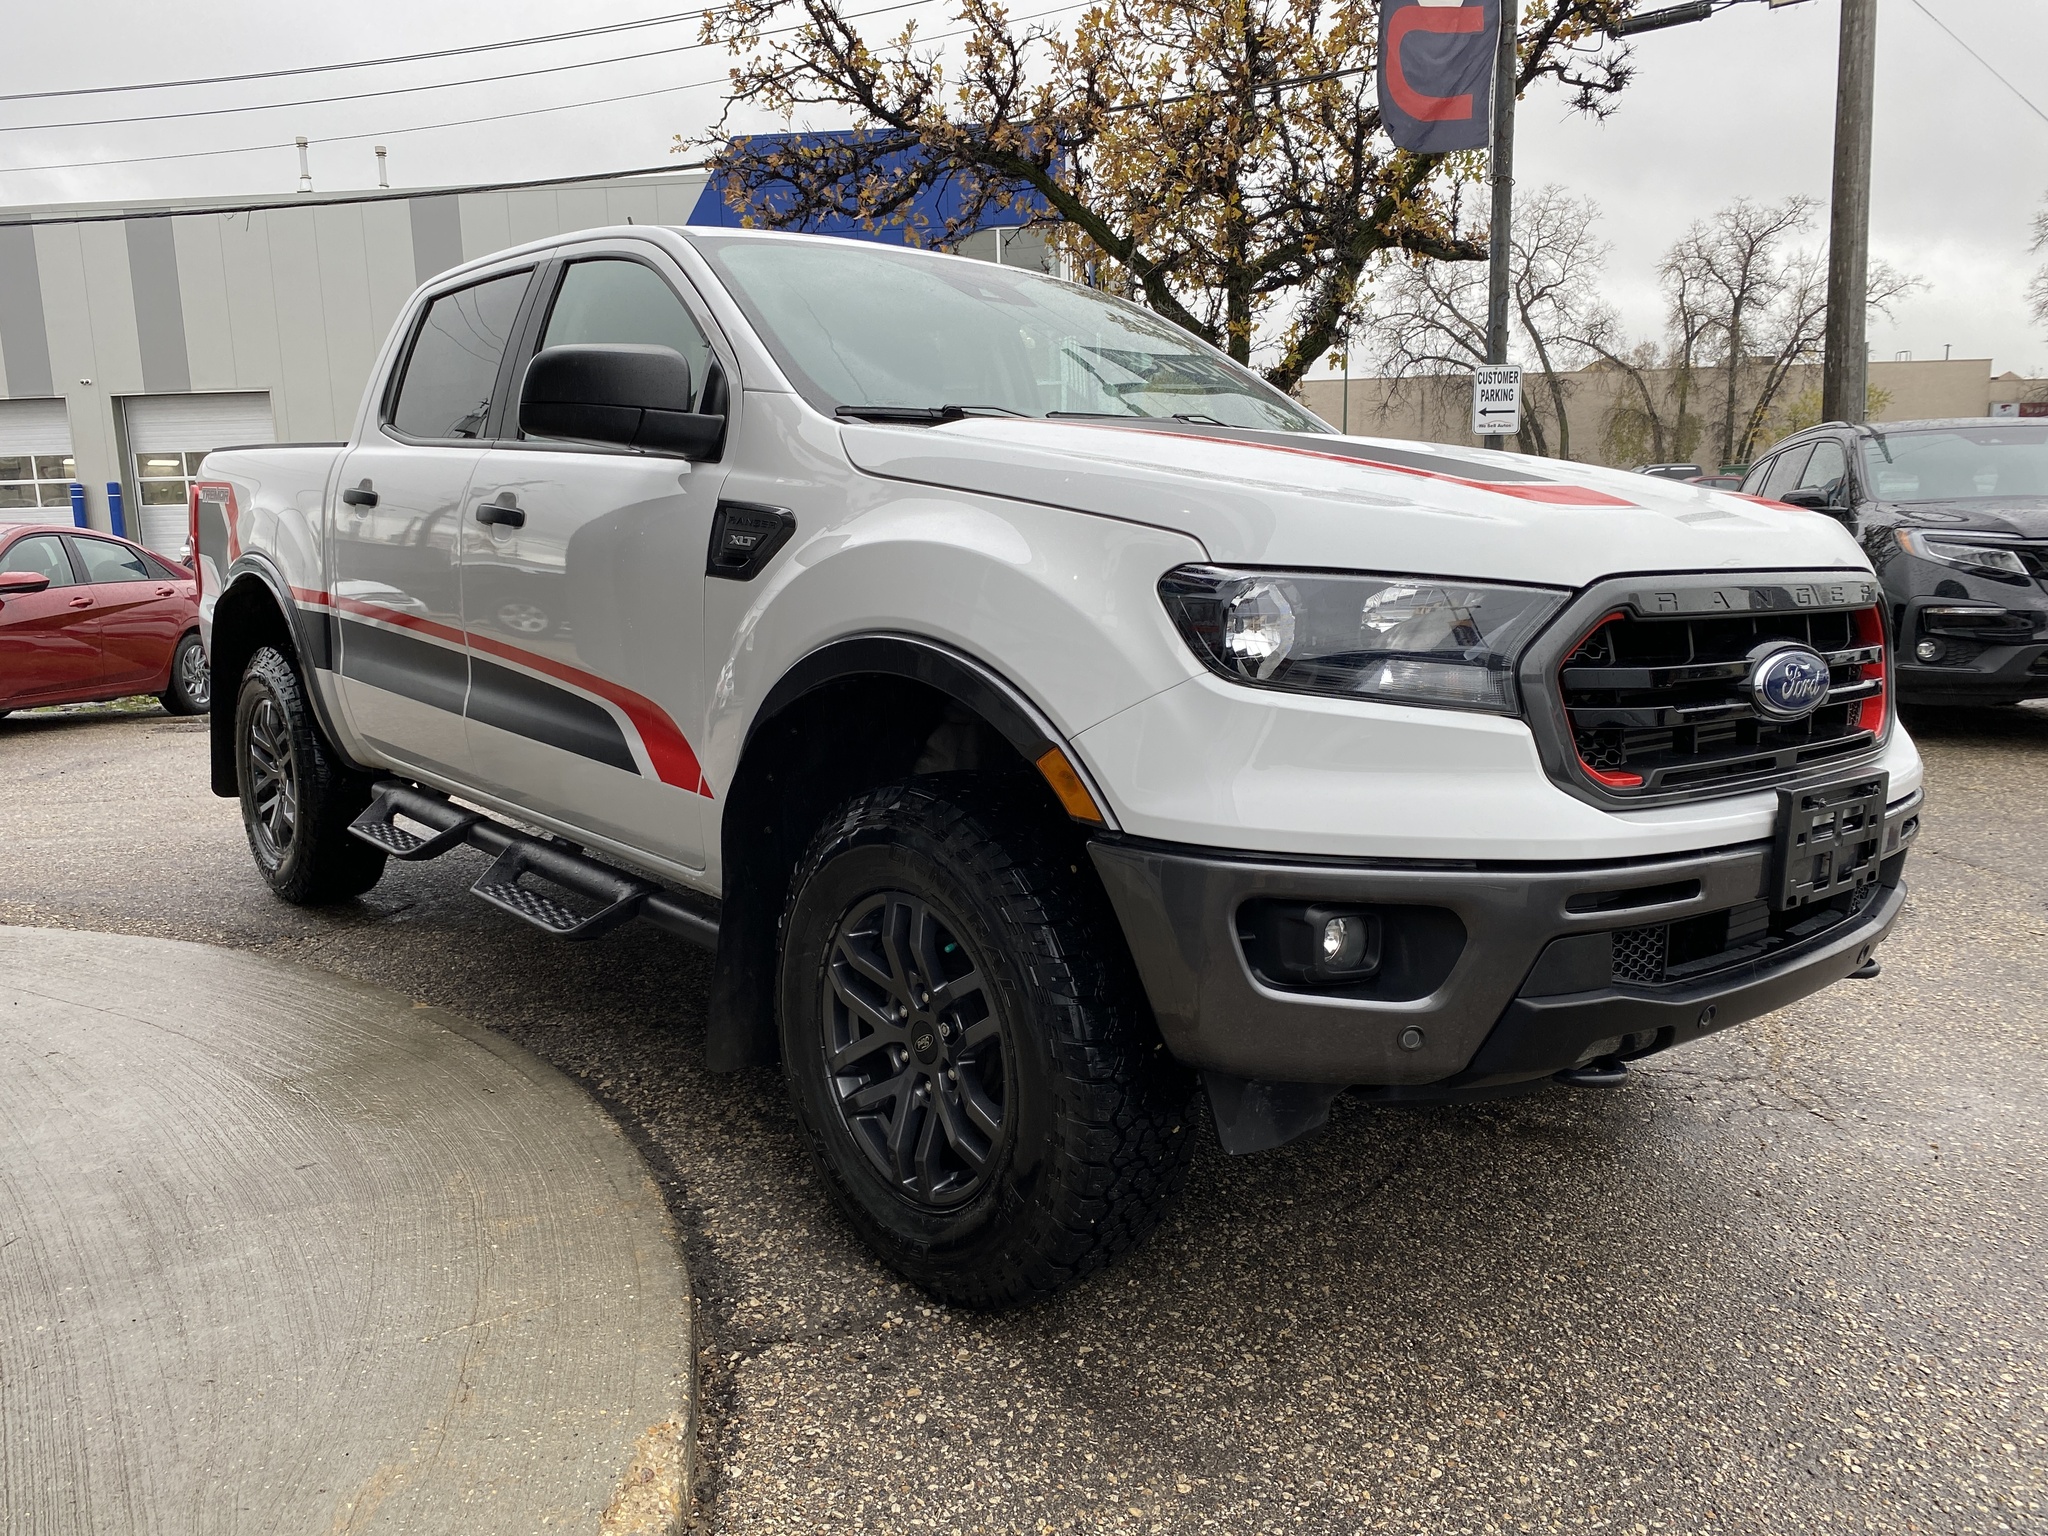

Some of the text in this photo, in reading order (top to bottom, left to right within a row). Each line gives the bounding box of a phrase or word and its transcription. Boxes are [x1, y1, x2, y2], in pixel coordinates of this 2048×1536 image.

[1477, 371, 1519, 385] CUSTOMER
[1480, 388, 1514, 402] PARKING
[201, 487, 229, 503] TREMOR
[728, 516, 778, 530] RANGER
[729, 534, 757, 547] XLT
[1654, 584, 1878, 611] RANGER
[1781, 663, 1822, 700] Ford
